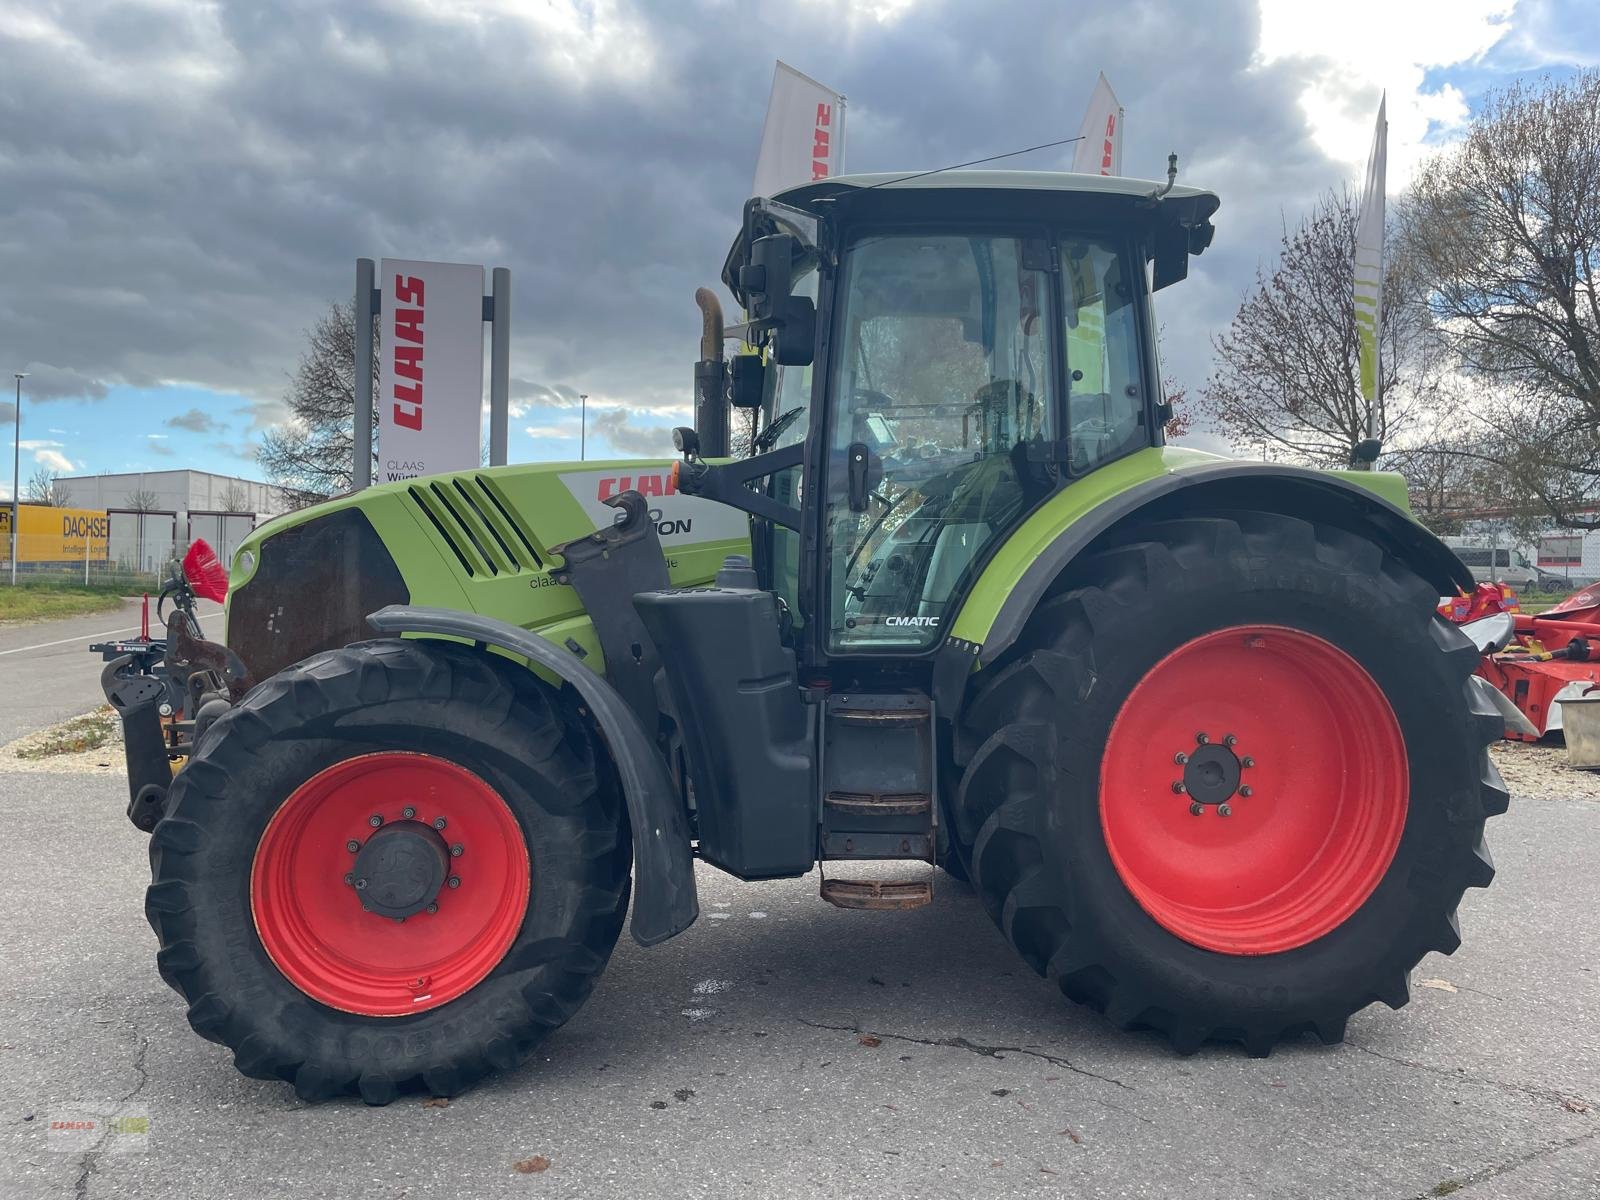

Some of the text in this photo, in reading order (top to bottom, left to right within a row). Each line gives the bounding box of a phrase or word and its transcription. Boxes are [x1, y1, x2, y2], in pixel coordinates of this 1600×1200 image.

[393, 272, 425, 432] CLAAS
[386, 460, 425, 471] CLAAS
[597, 474, 677, 501] CLA
[63, 515, 107, 538] DACHSE
[530, 576, 557, 589] claa
[885, 616, 940, 626] CMATIC
